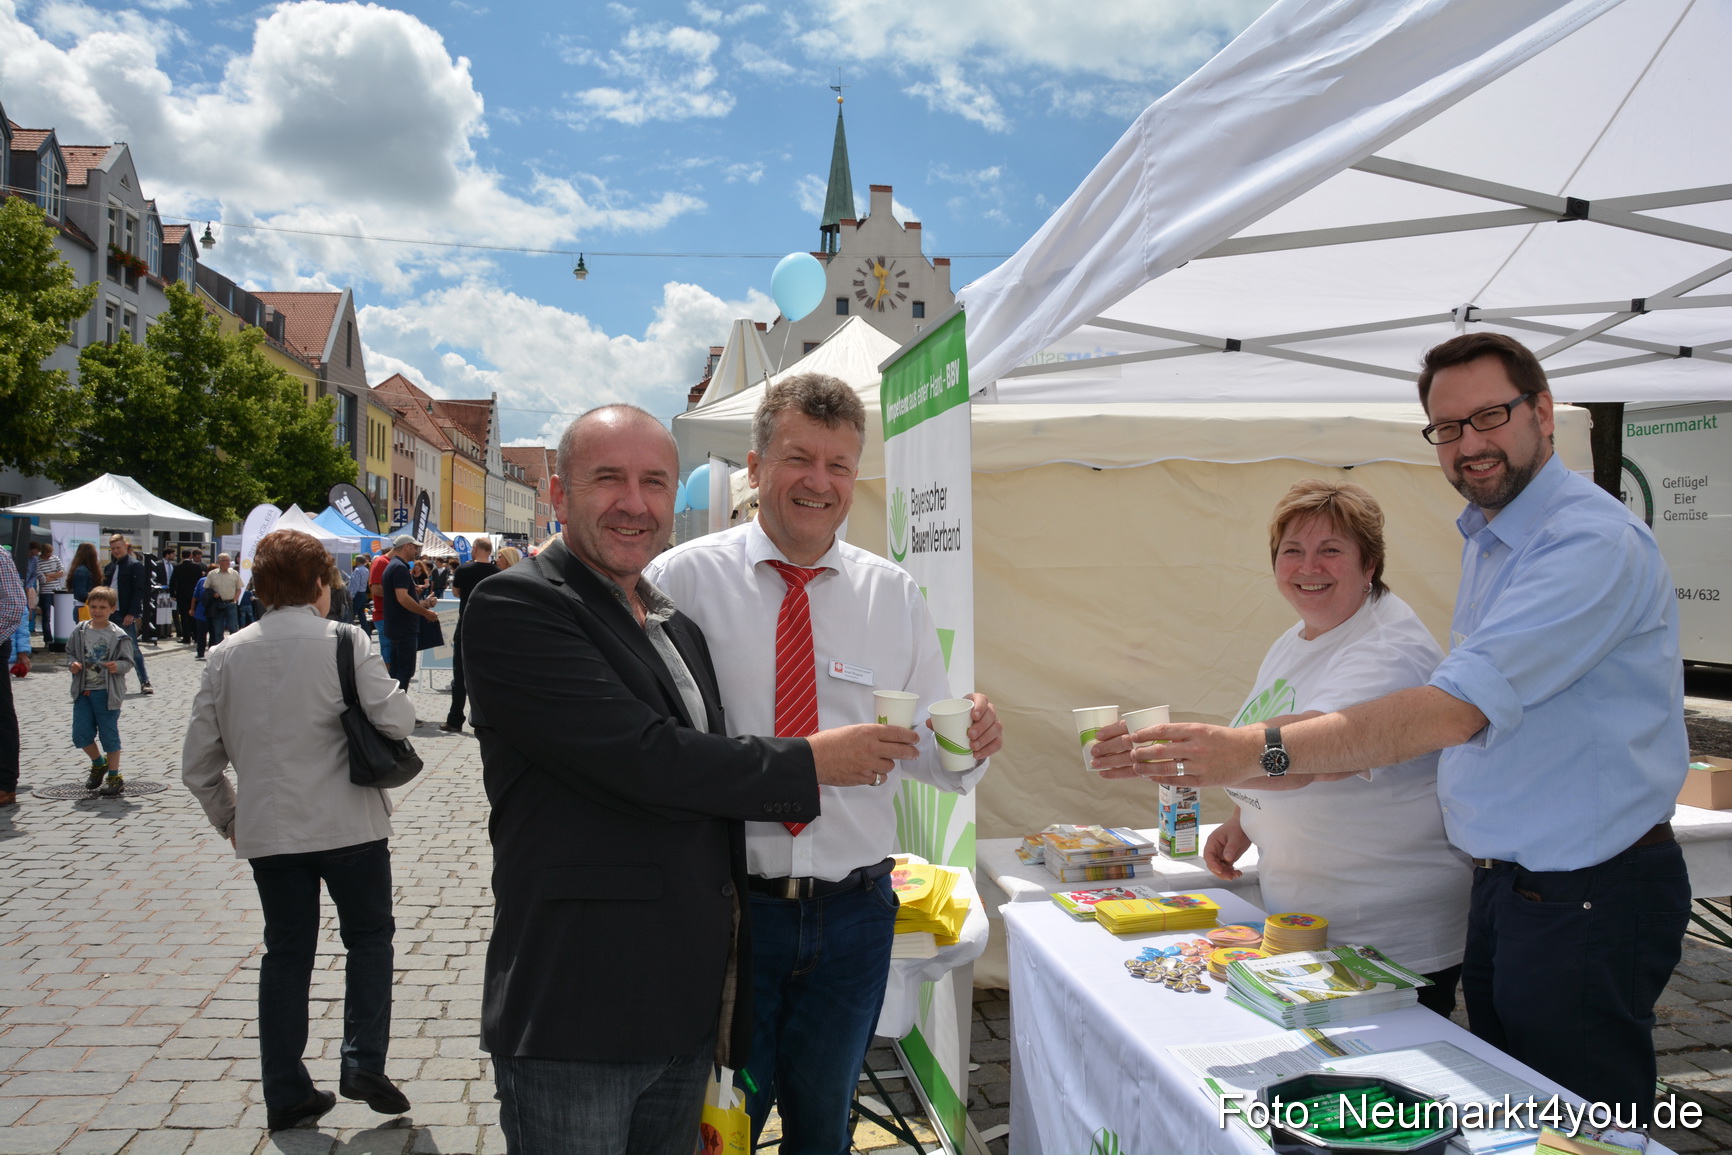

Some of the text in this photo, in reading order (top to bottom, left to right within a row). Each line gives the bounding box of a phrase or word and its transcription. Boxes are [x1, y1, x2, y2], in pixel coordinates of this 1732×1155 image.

[946, 358, 960, 389] BBV
[1626, 415, 1718, 437] Bauernmarkt
[1662, 475, 1708, 490] Geflügel
[911, 481, 948, 522] Bayerischer
[1674, 493, 1697, 505] Eier
[1663, 509, 1708, 521] Gemüse
[911, 518, 961, 554] BauernVerband
